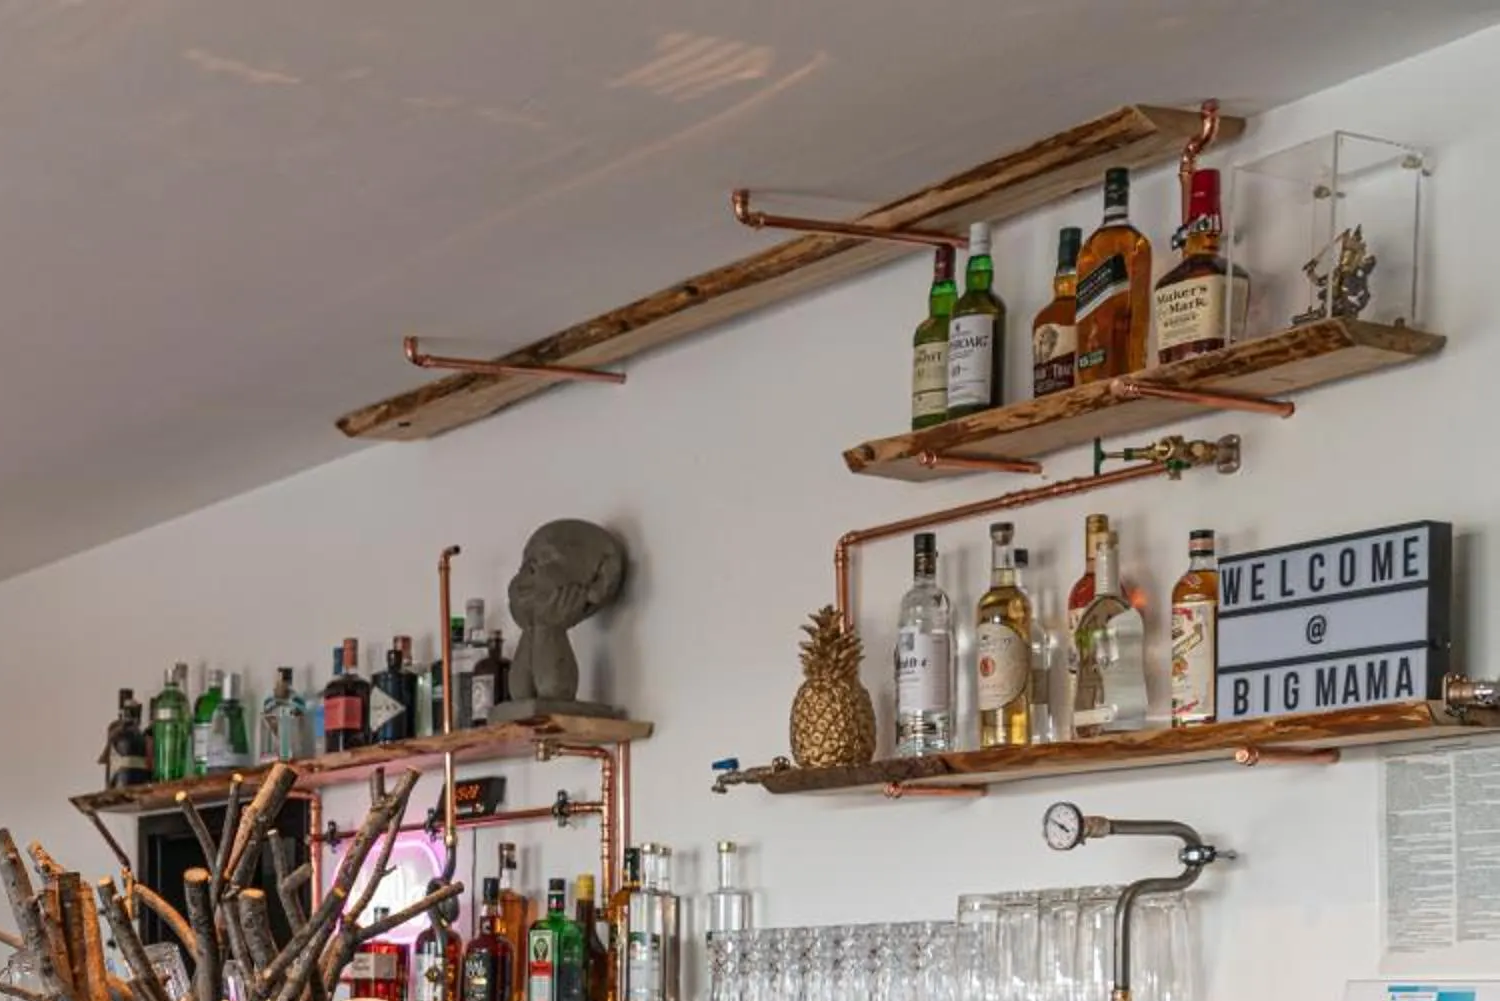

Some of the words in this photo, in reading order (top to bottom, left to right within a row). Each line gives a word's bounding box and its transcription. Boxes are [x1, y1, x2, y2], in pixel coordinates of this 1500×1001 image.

[1221, 535, 1420, 606] WELCOME
[1305, 614, 1328, 645] @
[1233, 670, 1300, 716] BIG
[1314, 656, 1414, 707] MAMA
